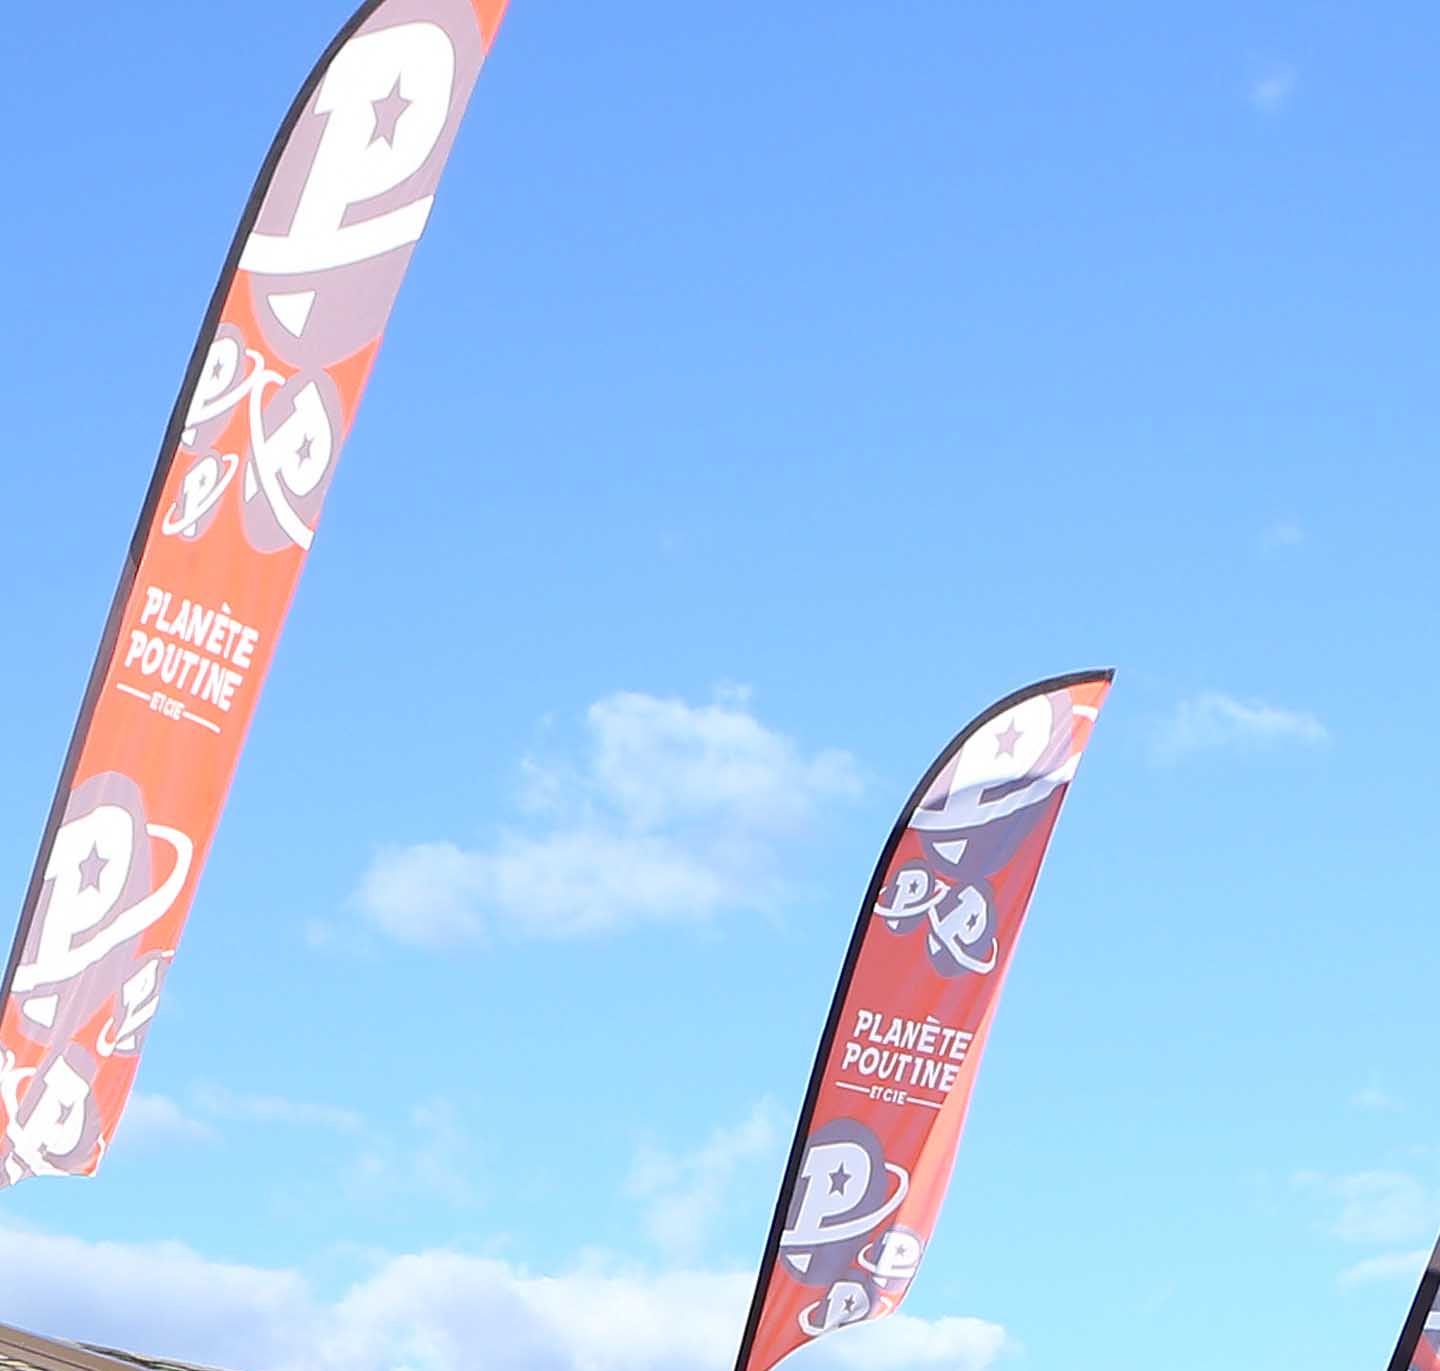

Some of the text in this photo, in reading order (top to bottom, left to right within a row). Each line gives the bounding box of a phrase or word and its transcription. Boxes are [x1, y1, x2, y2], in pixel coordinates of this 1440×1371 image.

[140, 586, 259, 669] PLANÈTE
[124, 629, 243, 712] POUTINE
[149, 691, 167, 713] ET
[853, 1009, 973, 1060] PLANÈTE
[842, 1042, 960, 1092] POUTINE
[870, 1085, 907, 1105] ET CIE
